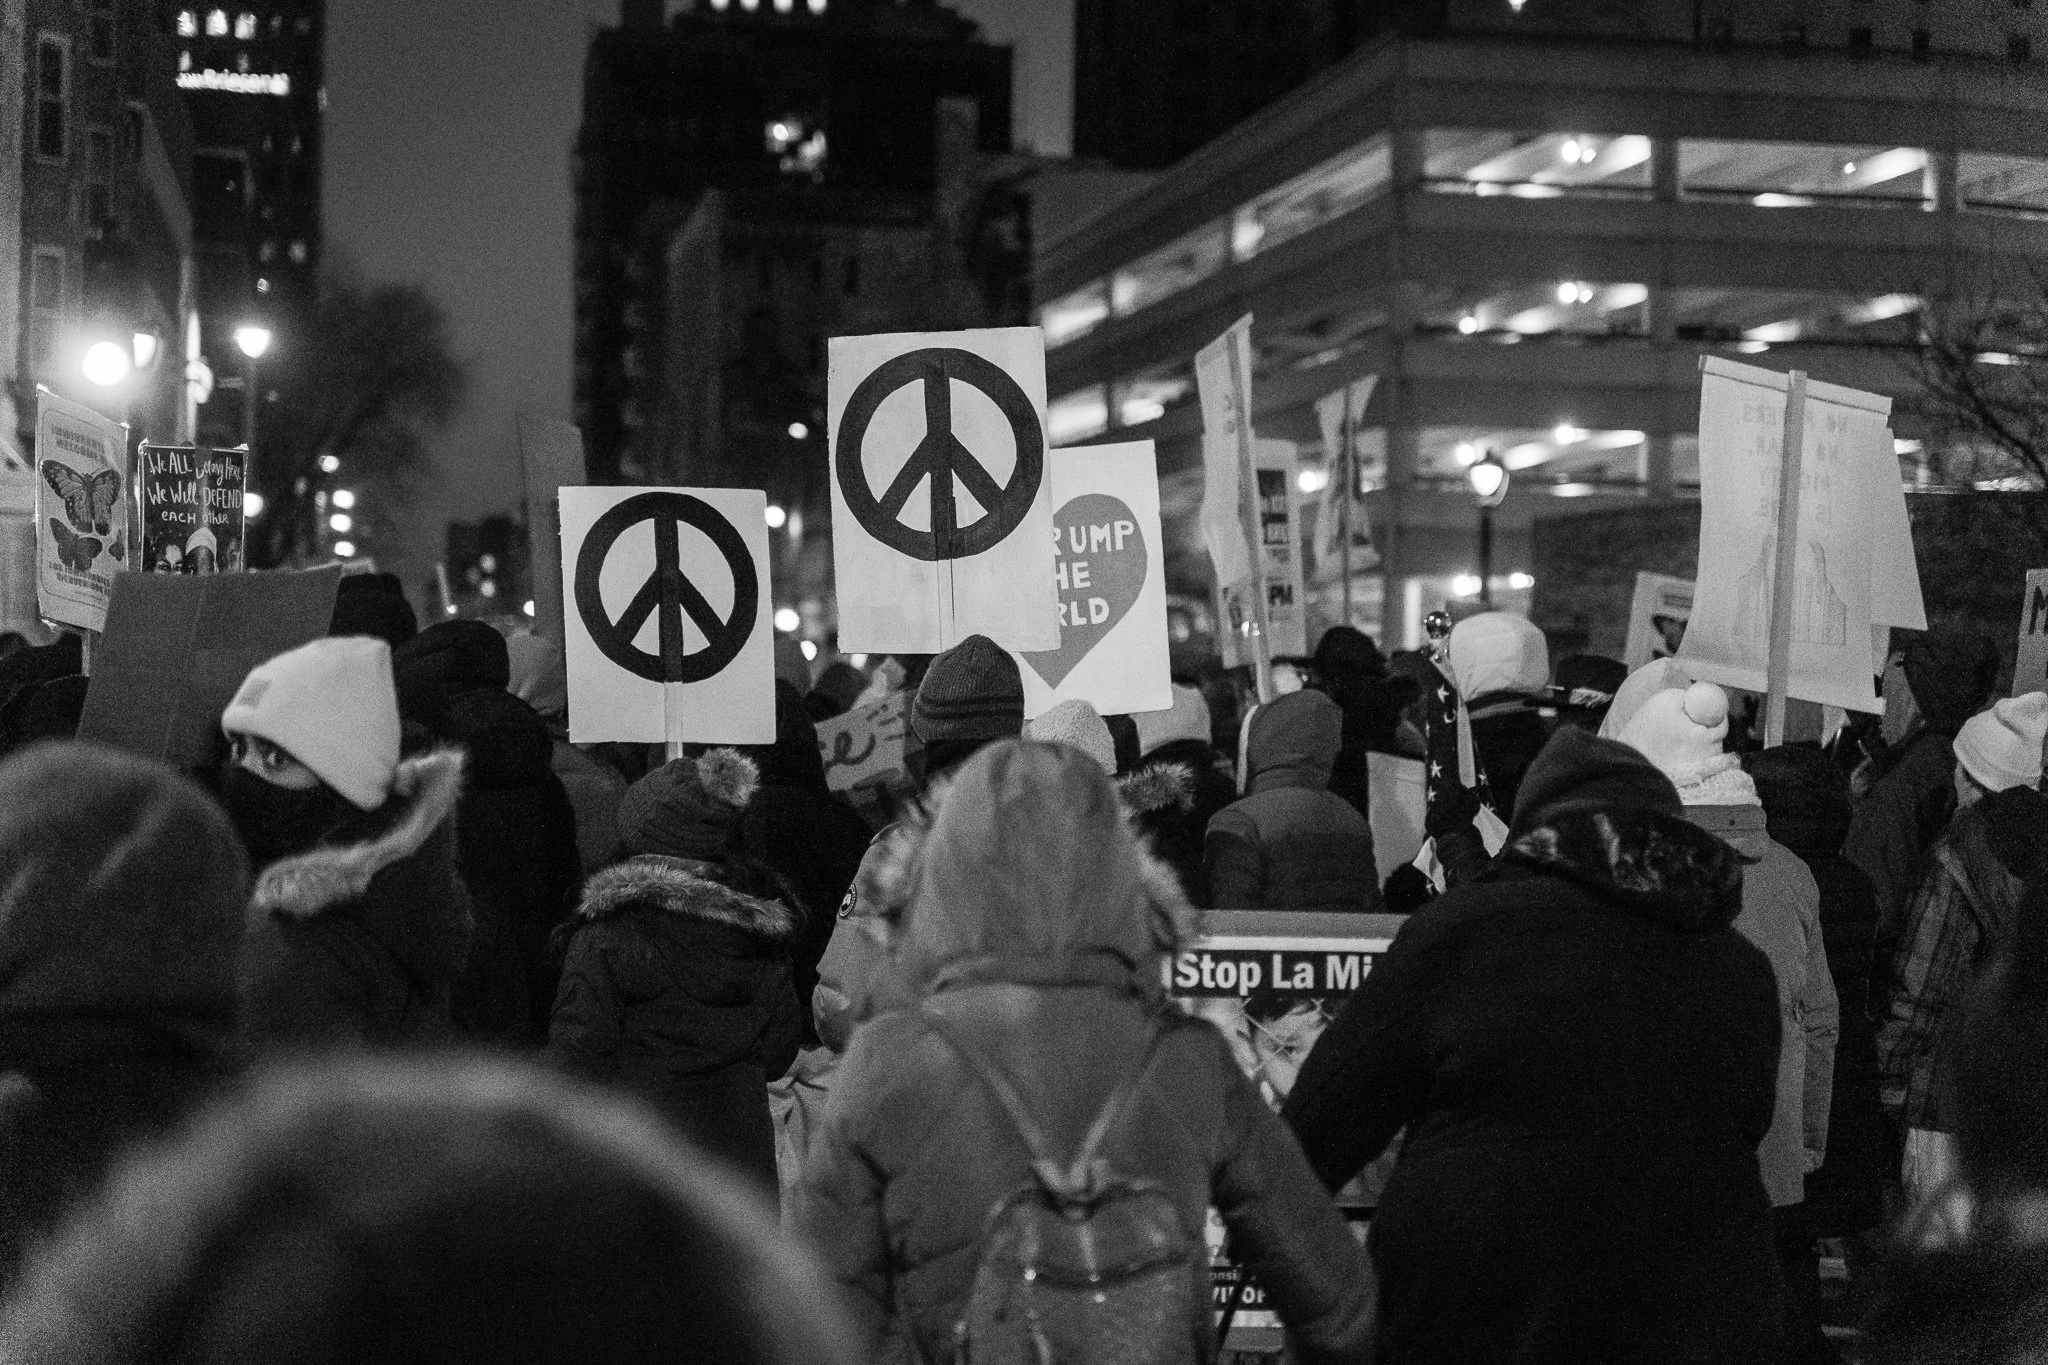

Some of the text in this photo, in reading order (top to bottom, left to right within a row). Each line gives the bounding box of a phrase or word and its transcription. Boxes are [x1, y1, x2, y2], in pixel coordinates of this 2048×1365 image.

[147, 452, 167, 475] We
[169, 451, 193, 475] ALL
[146, 481, 168, 506] We
[169, 480, 199, 506] Will
[1174, 952, 1262, 997] Stop
[1271, 953, 1315, 990] La
